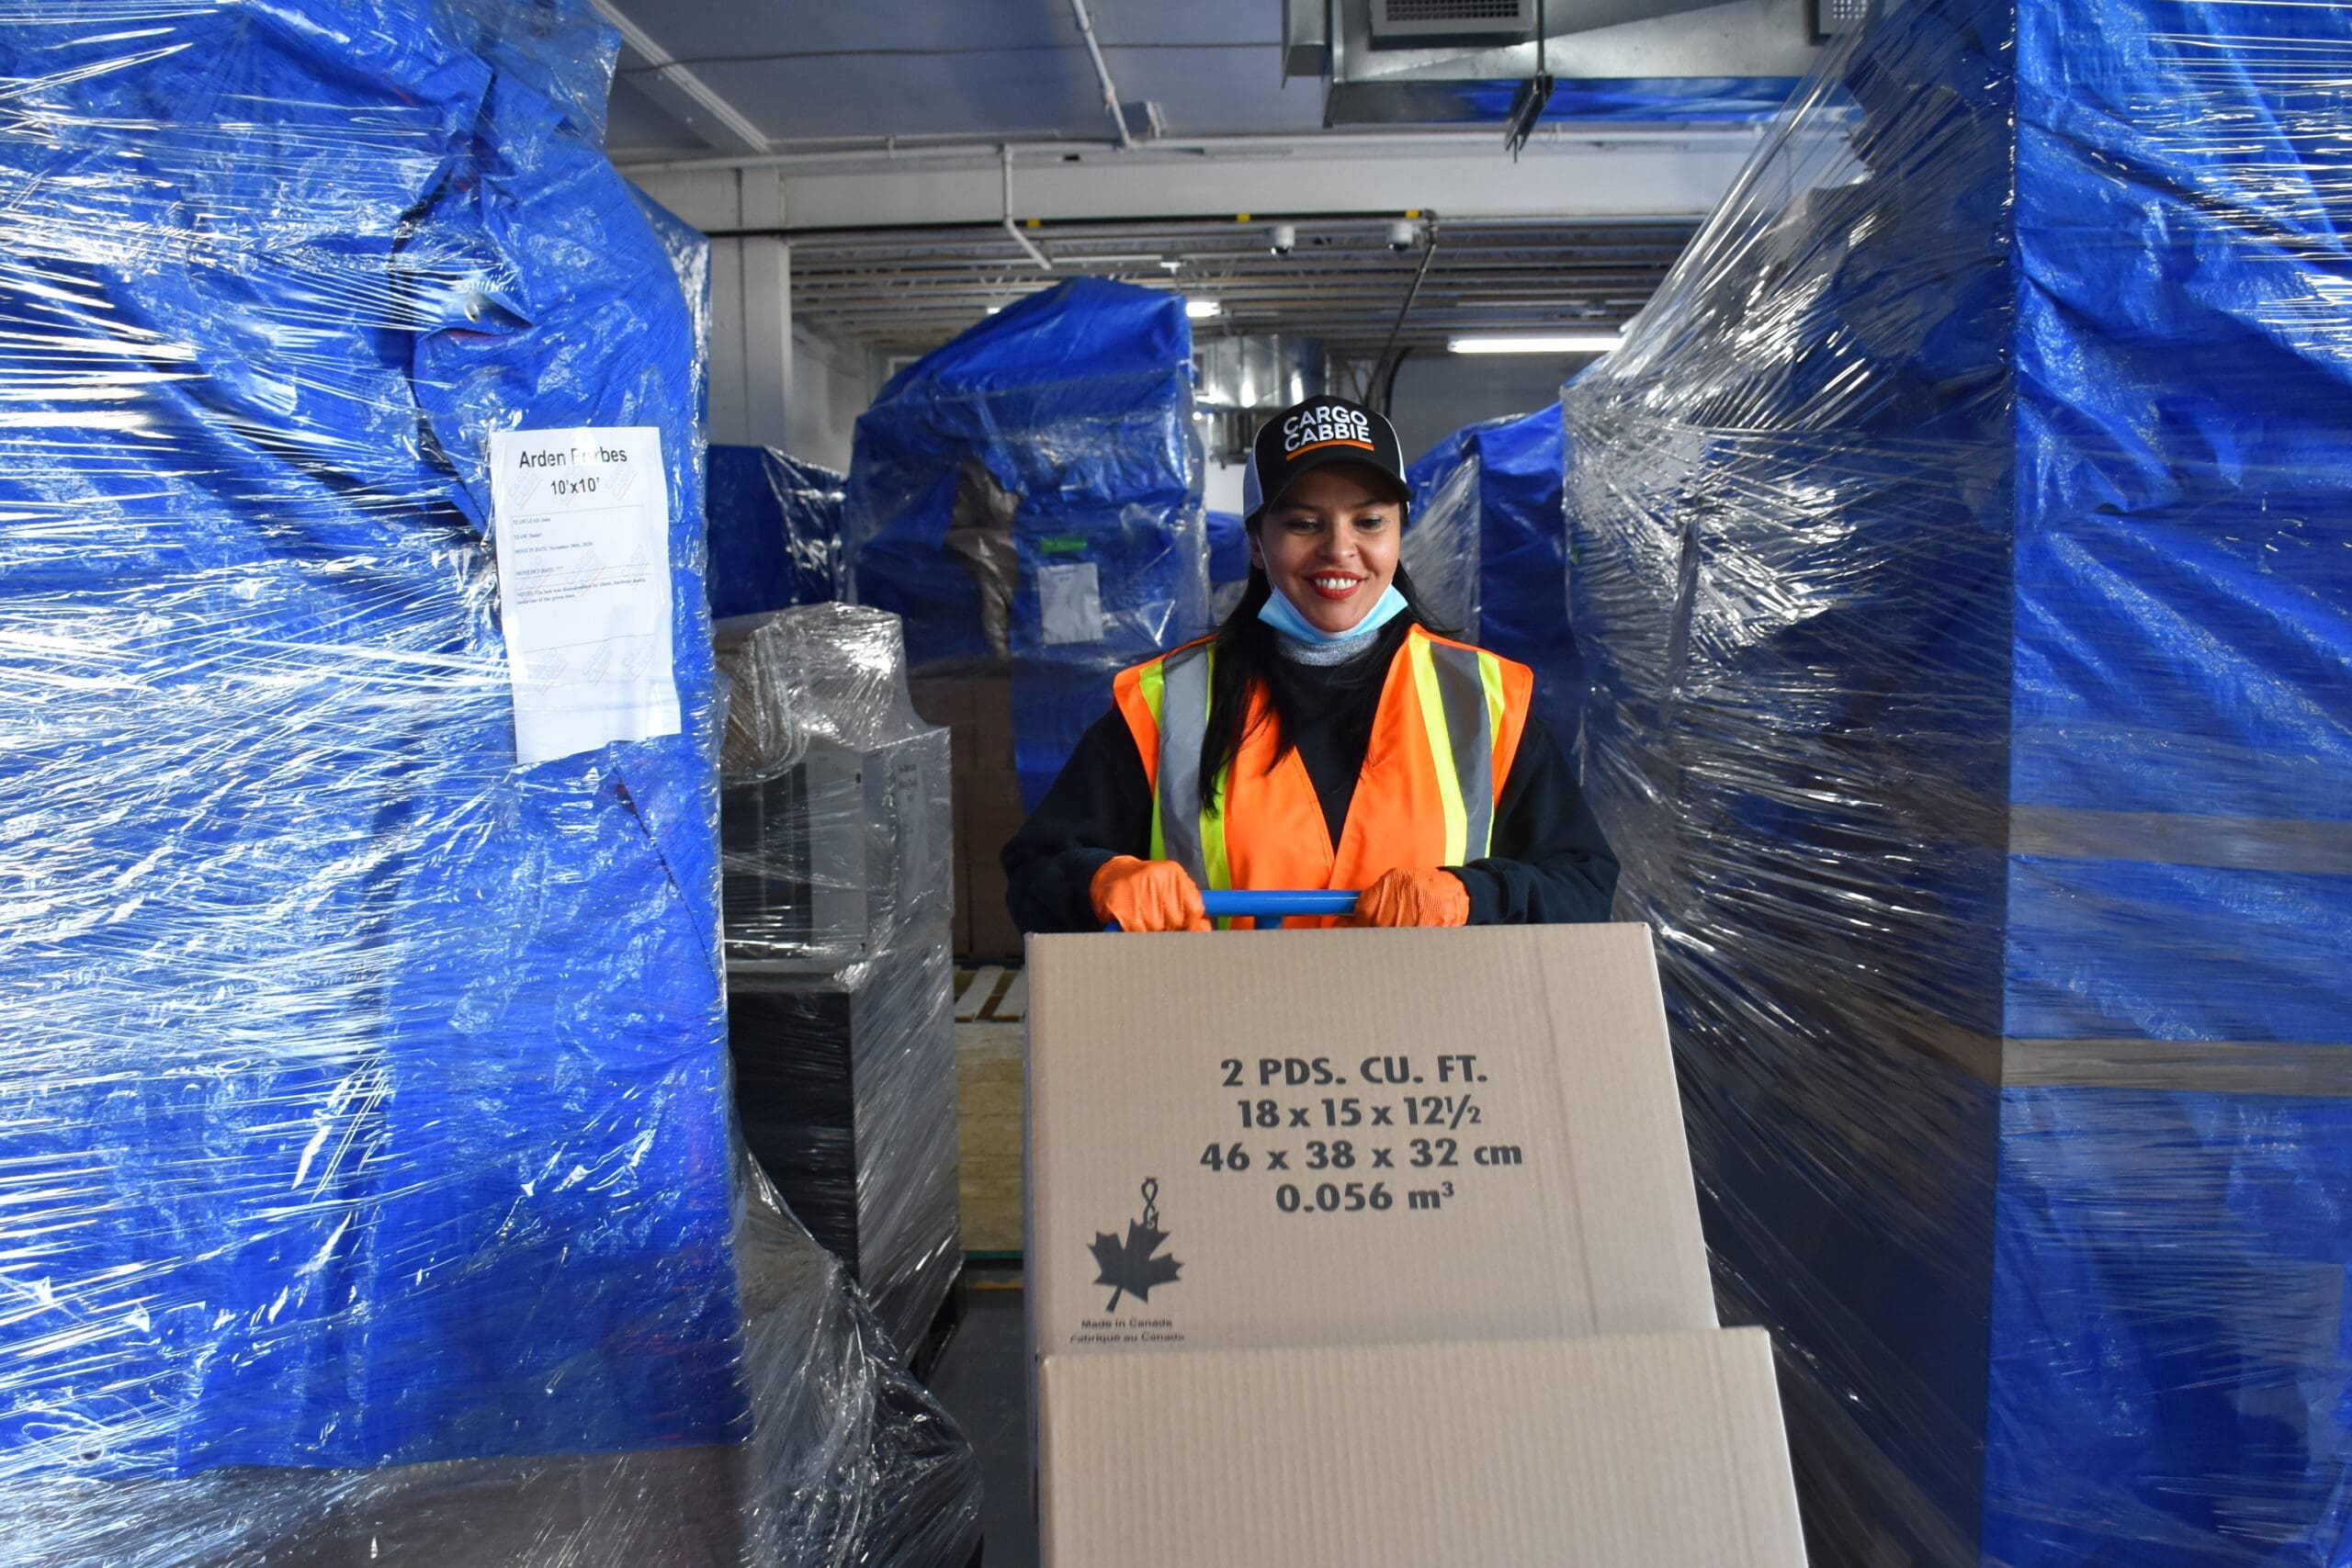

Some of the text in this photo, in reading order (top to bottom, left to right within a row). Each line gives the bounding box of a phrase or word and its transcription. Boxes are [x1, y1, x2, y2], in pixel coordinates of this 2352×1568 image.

[1283, 405, 1368, 435] CARGO
[1284, 423, 1373, 452] CABBIE
[519, 449, 567, 469] Arden
[1220, 1054, 1488, 1088] 2 PDS. CU. FT.
[1238, 1099, 1281, 1129] 18
[1287, 1107, 1311, 1128] x
[1320, 1097, 1363, 1127] 15
[1371, 1104, 1395, 1126] x
[1199, 1137, 1523, 1172] 46 x 38 x 32 cm
[1275, 1181, 1393, 1213] 0.056
[1081, 1318, 1113, 1330] Made
[1128, 1316, 1173, 1329] Canada
